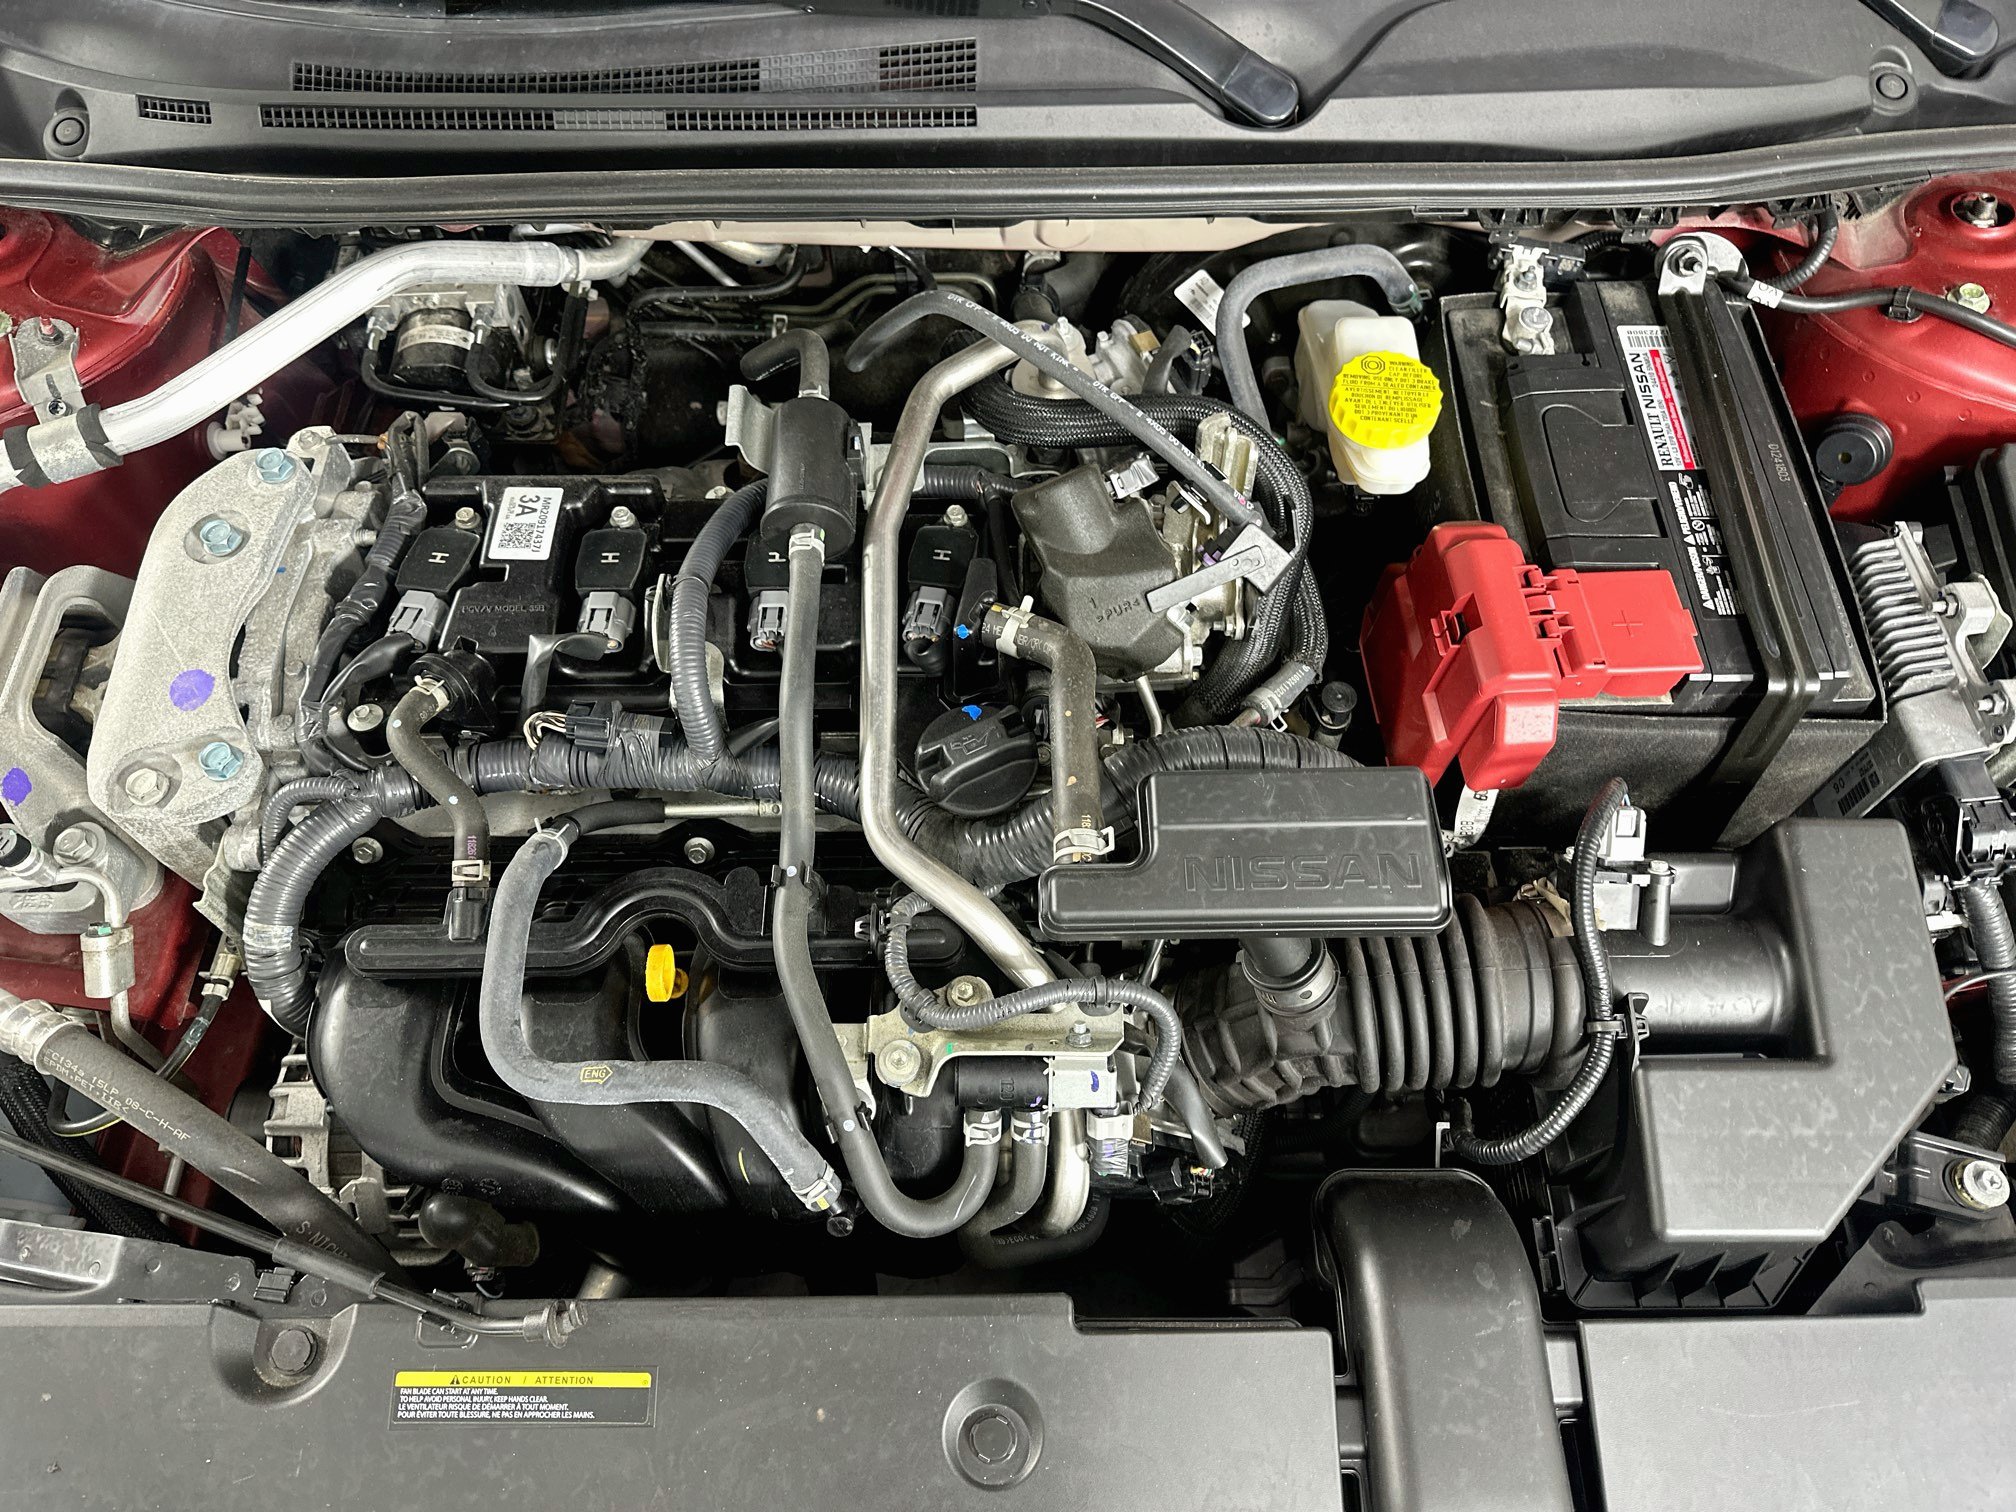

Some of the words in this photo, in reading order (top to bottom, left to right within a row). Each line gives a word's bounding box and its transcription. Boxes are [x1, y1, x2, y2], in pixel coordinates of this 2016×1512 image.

[1629, 352, 1656, 409] NISSAN
[1648, 412, 1674, 467] RENAULT
[515, 494, 541, 517] 3A
[1183, 853, 1423, 891] NISSAN
[584, 1069, 606, 1079] ENG
[462, 1376, 511, 1384] CAUTION
[535, 1376, 594, 1384] ATTENTION
